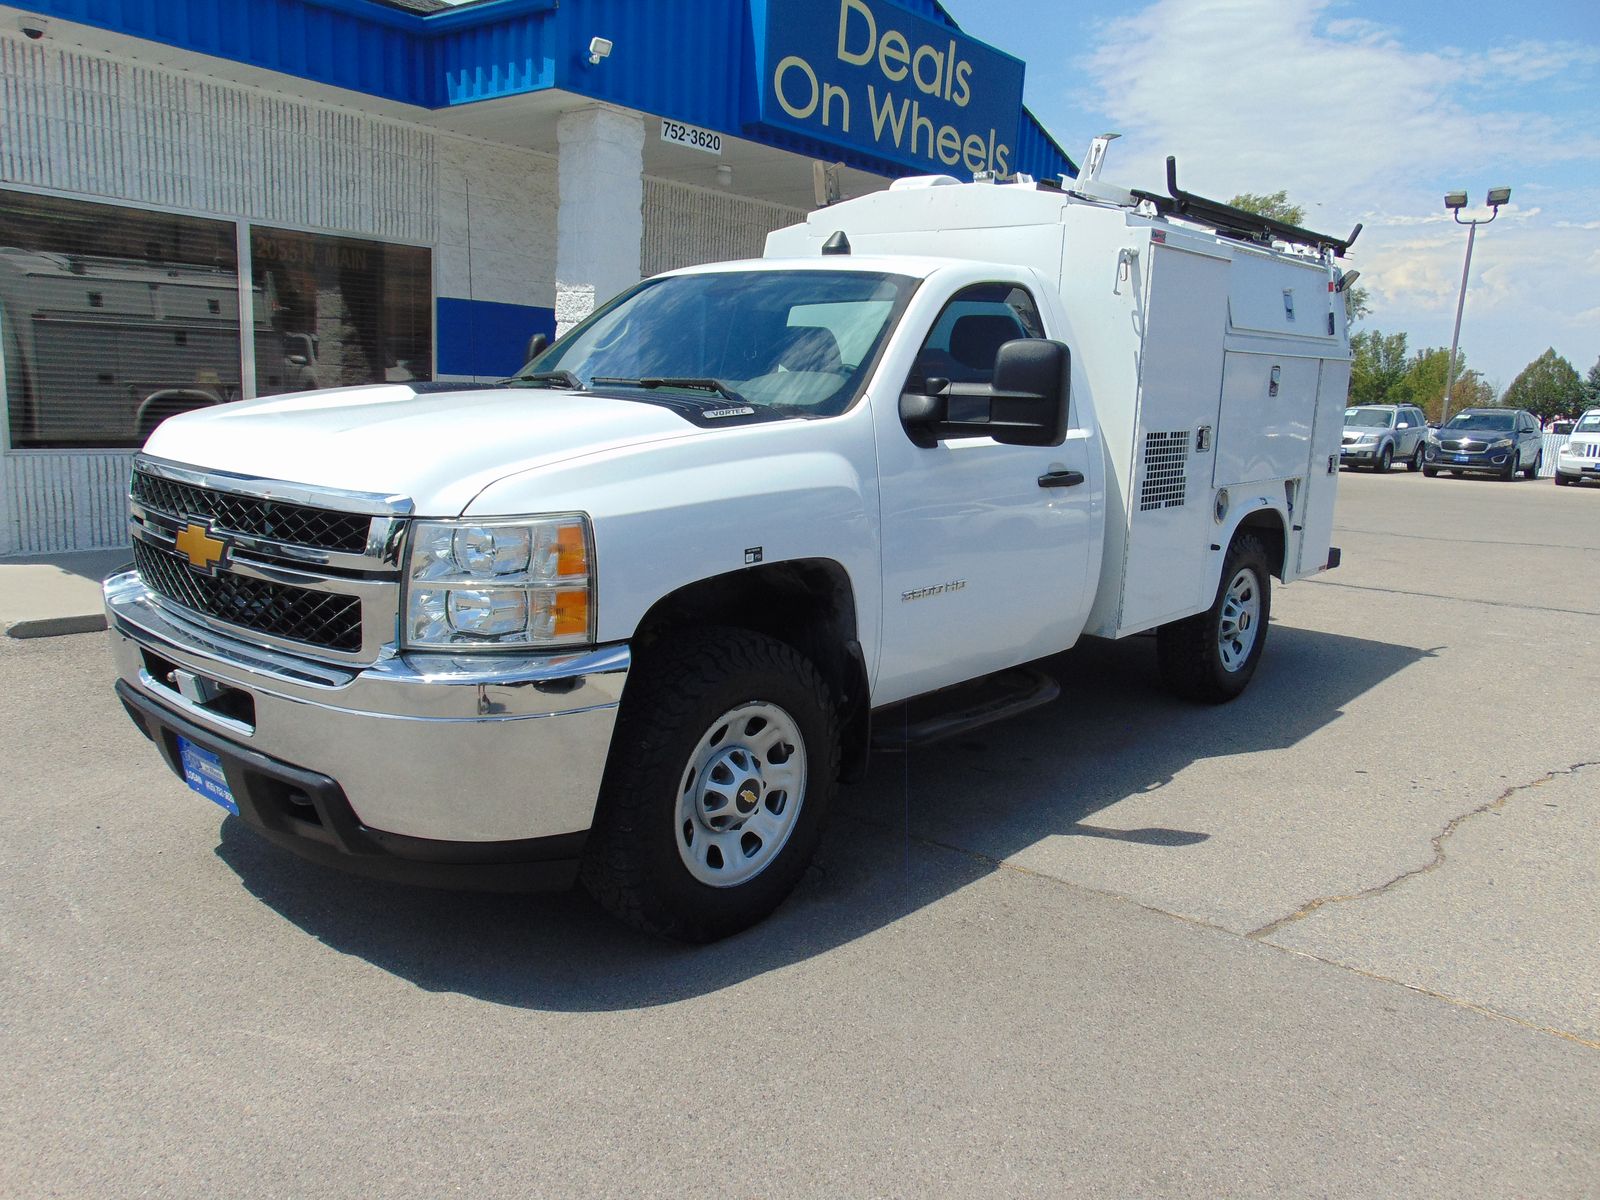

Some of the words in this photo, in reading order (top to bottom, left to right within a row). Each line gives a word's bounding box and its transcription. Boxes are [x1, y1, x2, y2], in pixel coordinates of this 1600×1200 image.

[838, 0, 972, 107] Deals
[774, 56, 849, 132] On
[868, 84, 1009, 181] Wheels
[663, 121, 721, 151] 752-3620
[325, 245, 368, 272] MAIN
[712, 408, 747, 417] VORTEC
